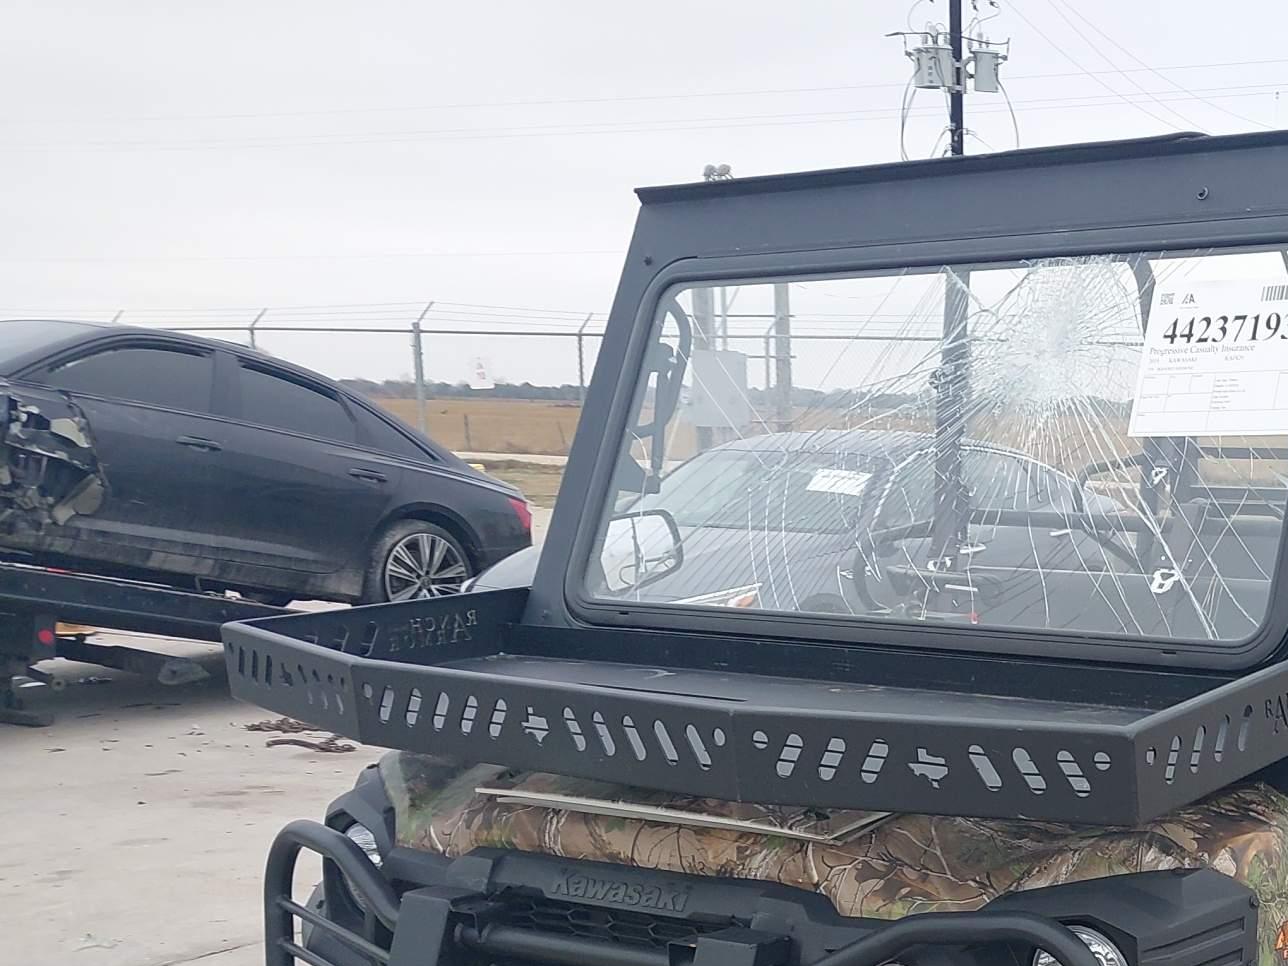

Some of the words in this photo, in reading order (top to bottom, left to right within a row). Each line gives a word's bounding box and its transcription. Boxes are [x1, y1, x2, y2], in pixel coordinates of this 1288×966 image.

[1190, 344, 1218, 355] Casualty
[1221, 343, 1256, 353] Insurance
[550, 870, 689, 913] Kawasaki
